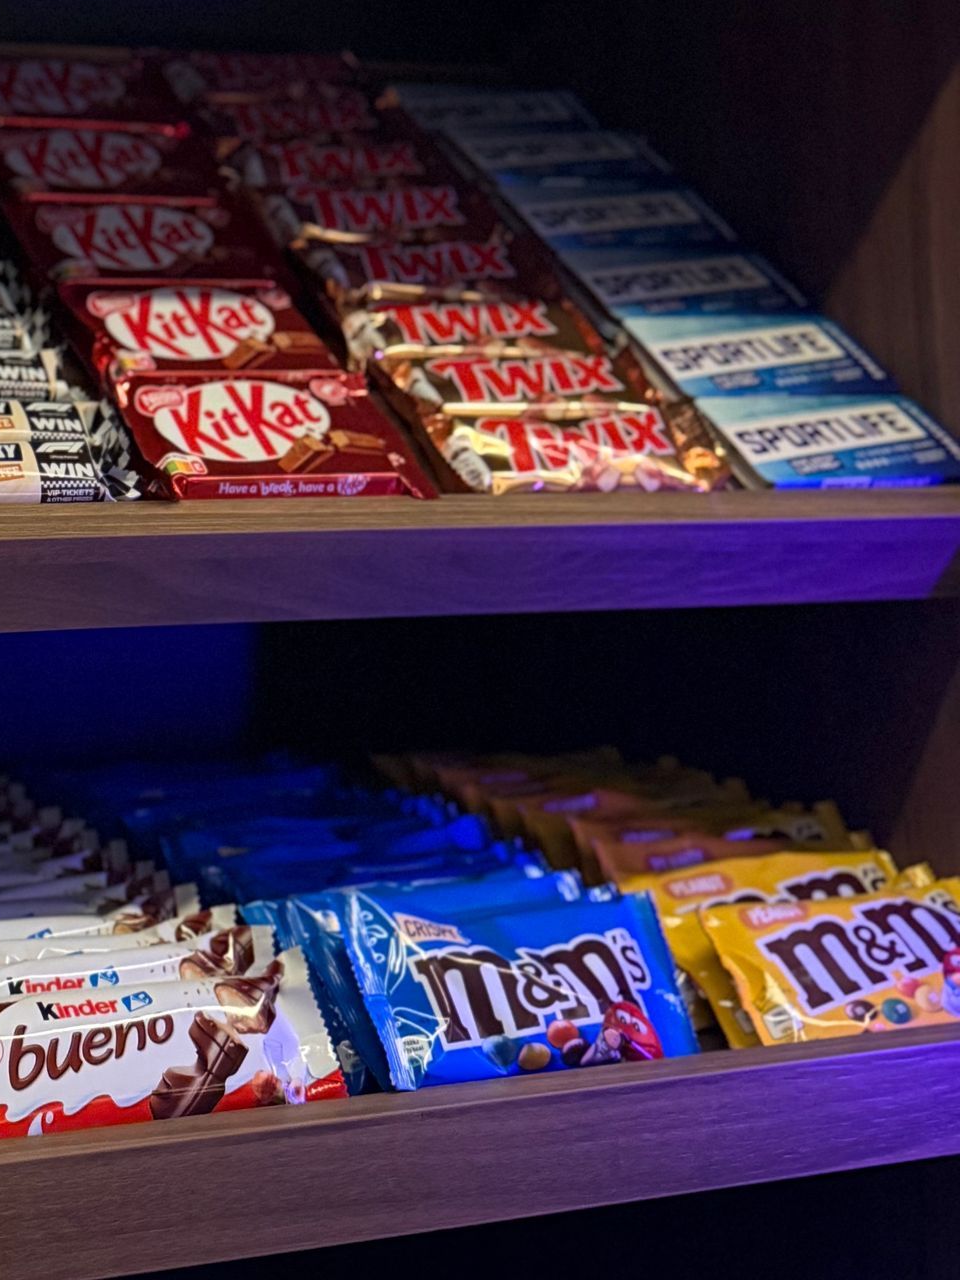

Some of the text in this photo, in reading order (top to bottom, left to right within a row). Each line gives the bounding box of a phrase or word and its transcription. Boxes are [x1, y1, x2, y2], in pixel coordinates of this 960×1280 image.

[69, 205, 203, 267] KitKat
[122, 289, 266, 359] KitKat
[372, 302, 556, 345] TWIX
[660, 329, 832, 372] SPORTLIFE
[428, 356, 624, 402] TWIX
[30, 417, 82, 432] WIN
[168, 382, 323, 461] KitKat
[478, 408, 675, 473] TWIX
[734, 410, 912, 455] SPORTLIFE
[41, 463, 95, 478] WIN
[218, 482, 249, 494] Have
[249, 484, 258, 494] a
[298, 481, 325, 493] have
[326, 483, 335, 493] a
[7, 976, 85, 995] Kinder
[36, 999, 118, 1021] Kinder
[8, 1014, 174, 1092] bueno
